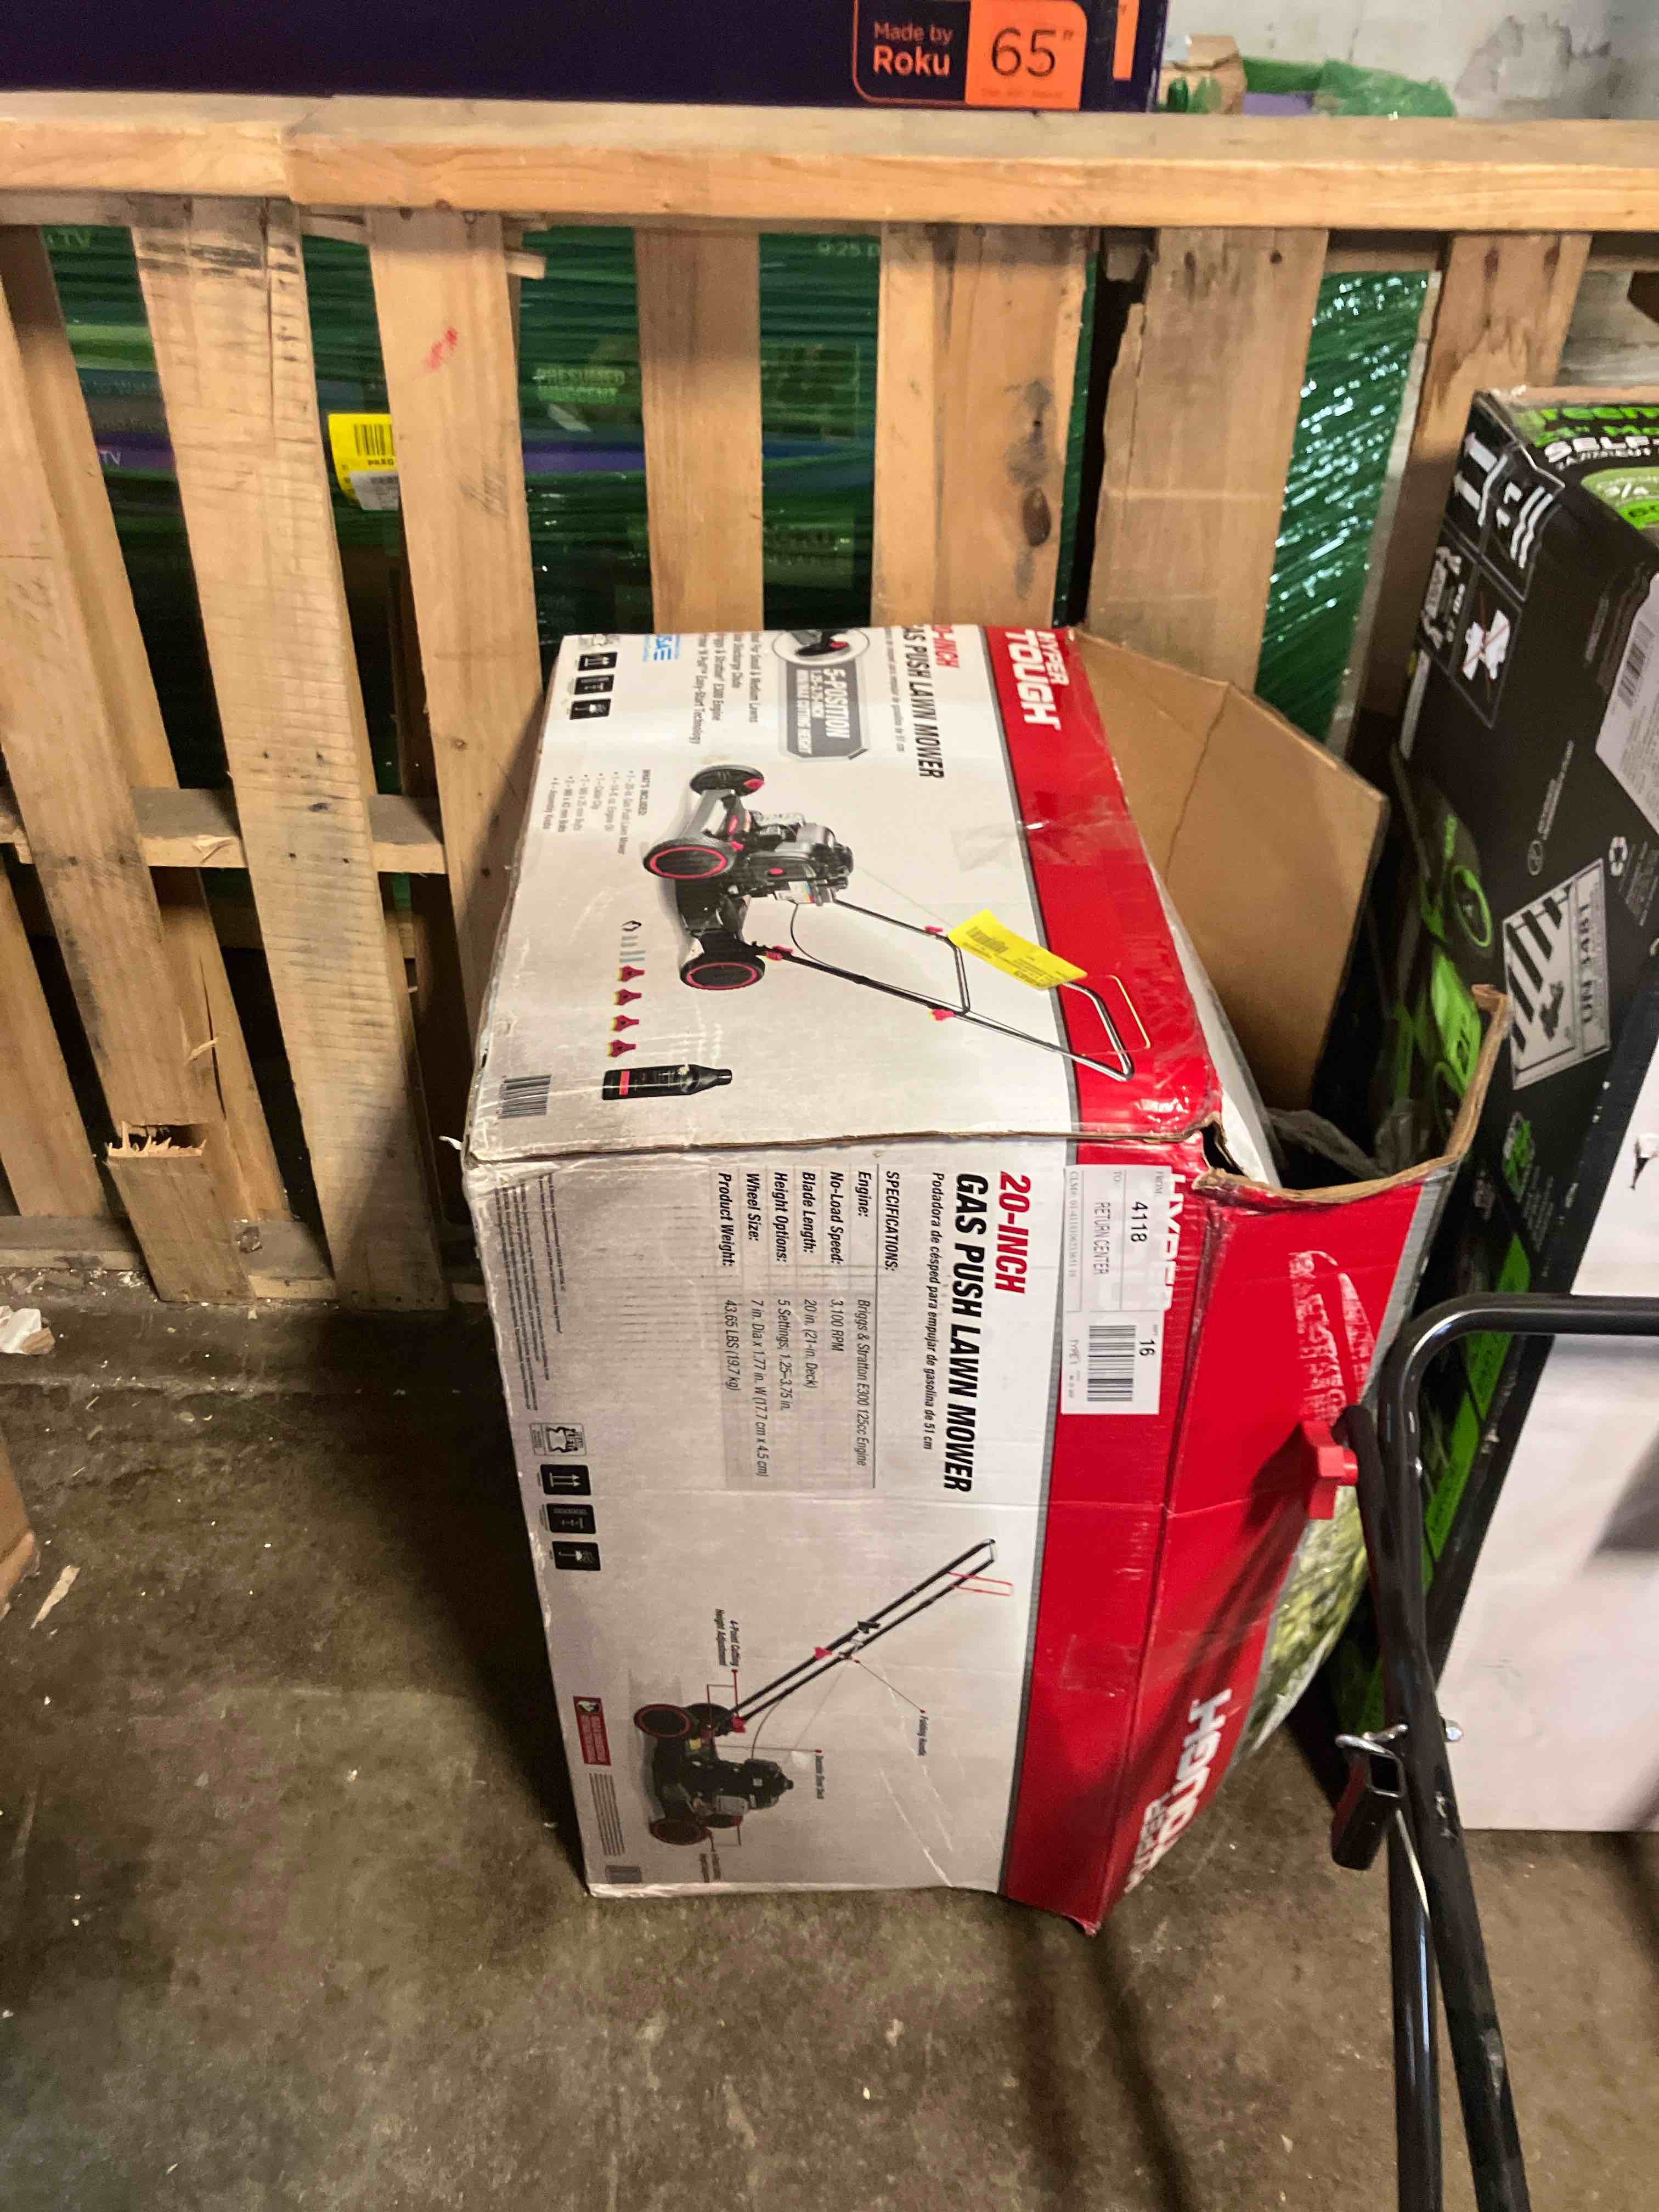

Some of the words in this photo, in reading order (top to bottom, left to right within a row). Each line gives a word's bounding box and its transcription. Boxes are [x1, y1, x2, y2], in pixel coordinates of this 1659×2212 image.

[874, 21, 925, 41] Made
[930, 25, 952, 44] by
[873, 46, 950, 76] Roku
[903, 625, 927, 640] AS
[932, 625, 960, 668] 0-INCH
[905, 645, 931, 678] PUSH
[1037, 631, 1069, 685] HYPER
[709, 700, 724, 721] Engine
[748, 703, 760, 723] Lawns
[823, 669, 850, 739] 5-POSITION
[909, 681, 938, 720] LAWN
[689, 709, 705, 745] Technology
[798, 729, 812, 754] HEIGHT
[914, 724, 944, 778] MOWER
[718, 1173, 732, 1221] Product
[746, 1173, 760, 1210] Wheel
[772, 1172, 788, 1211] Height
[802, 1172, 816, 1207] Blade
[829, 1172, 844, 1222] No-Load
[856, 1171, 871, 1217] Engine:
[930, 1172, 945, 1227] Podadora
[955, 1174, 988, 1234] GAS
[747, 1213, 761, 1241] Size:
[801, 1210, 816, 1253] Length:
[885, 1171, 899, 1272] SPECIFICATIONS:
[995, 1171, 1031, 1294] 20-INCH
[1094, 1203, 1110, 1238] RETURN
[1131, 1201, 1148, 1243] 4118
[719, 1224, 735, 1267] Weight:
[774, 1215, 788, 1262] Options:
[827, 1226, 843, 1265] Speed:
[930, 1230, 943, 1243] de
[927, 1246, 943, 1284] césped
[1093, 1240, 1110, 1274] CENTER
[952, 1243, 985, 1317] PUSH
[804, 1299, 816, 1312] 20
[927, 1286, 939, 1308] para
[724, 1300, 737, 1327] 43.65
[752, 1308, 763, 1320] in.
[804, 1314, 817, 1325] in.
[828, 1299, 843, 1327] 3,100
[854, 1300, 870, 1330] Briggs
[725, 1329, 738, 1348] LBS
[752, 1323, 764, 1338] Dia
[776, 1308, 791, 1350] Settings,
[831, 1330, 844, 1351] RPM
[924, 1312, 939, 1352] empujar
[803, 1329, 817, 1359] (21-in.
[1139, 1339, 1156, 1357] 16
[724, 1350, 739, 1374] (19.7
[753, 1351, 766, 1369] 1.77
[856, 1343, 869, 1381] Stratton
[926, 1355, 938, 1365] de
[949, 1324, 981, 1397] LAWN
[726, 1376, 741, 1391] kg)
[754, 1372, 766, 1383] in.
[803, 1362, 817, 1388] Deck)
[923, 1368, 938, 1407] gasolina
[755, 1386, 766, 1395] W
[856, 1383, 868, 1406] E300
[753, 1397, 768, 1420] (17.7
[781, 1401, 792, 1410] in.
[924, 1409, 936, 1420] de
[756, 1422, 766, 1435] cm
[856, 1409, 868, 1435] 125cc
[924, 1423, 935, 1434] 51
[757, 1446, 768, 1459] 4.5
[855, 1437, 868, 1465] Engine
[923, 1436, 933, 1449] cm
[944, 1403, 976, 1492] MOWER
[757, 1461, 770, 1477] cm)
